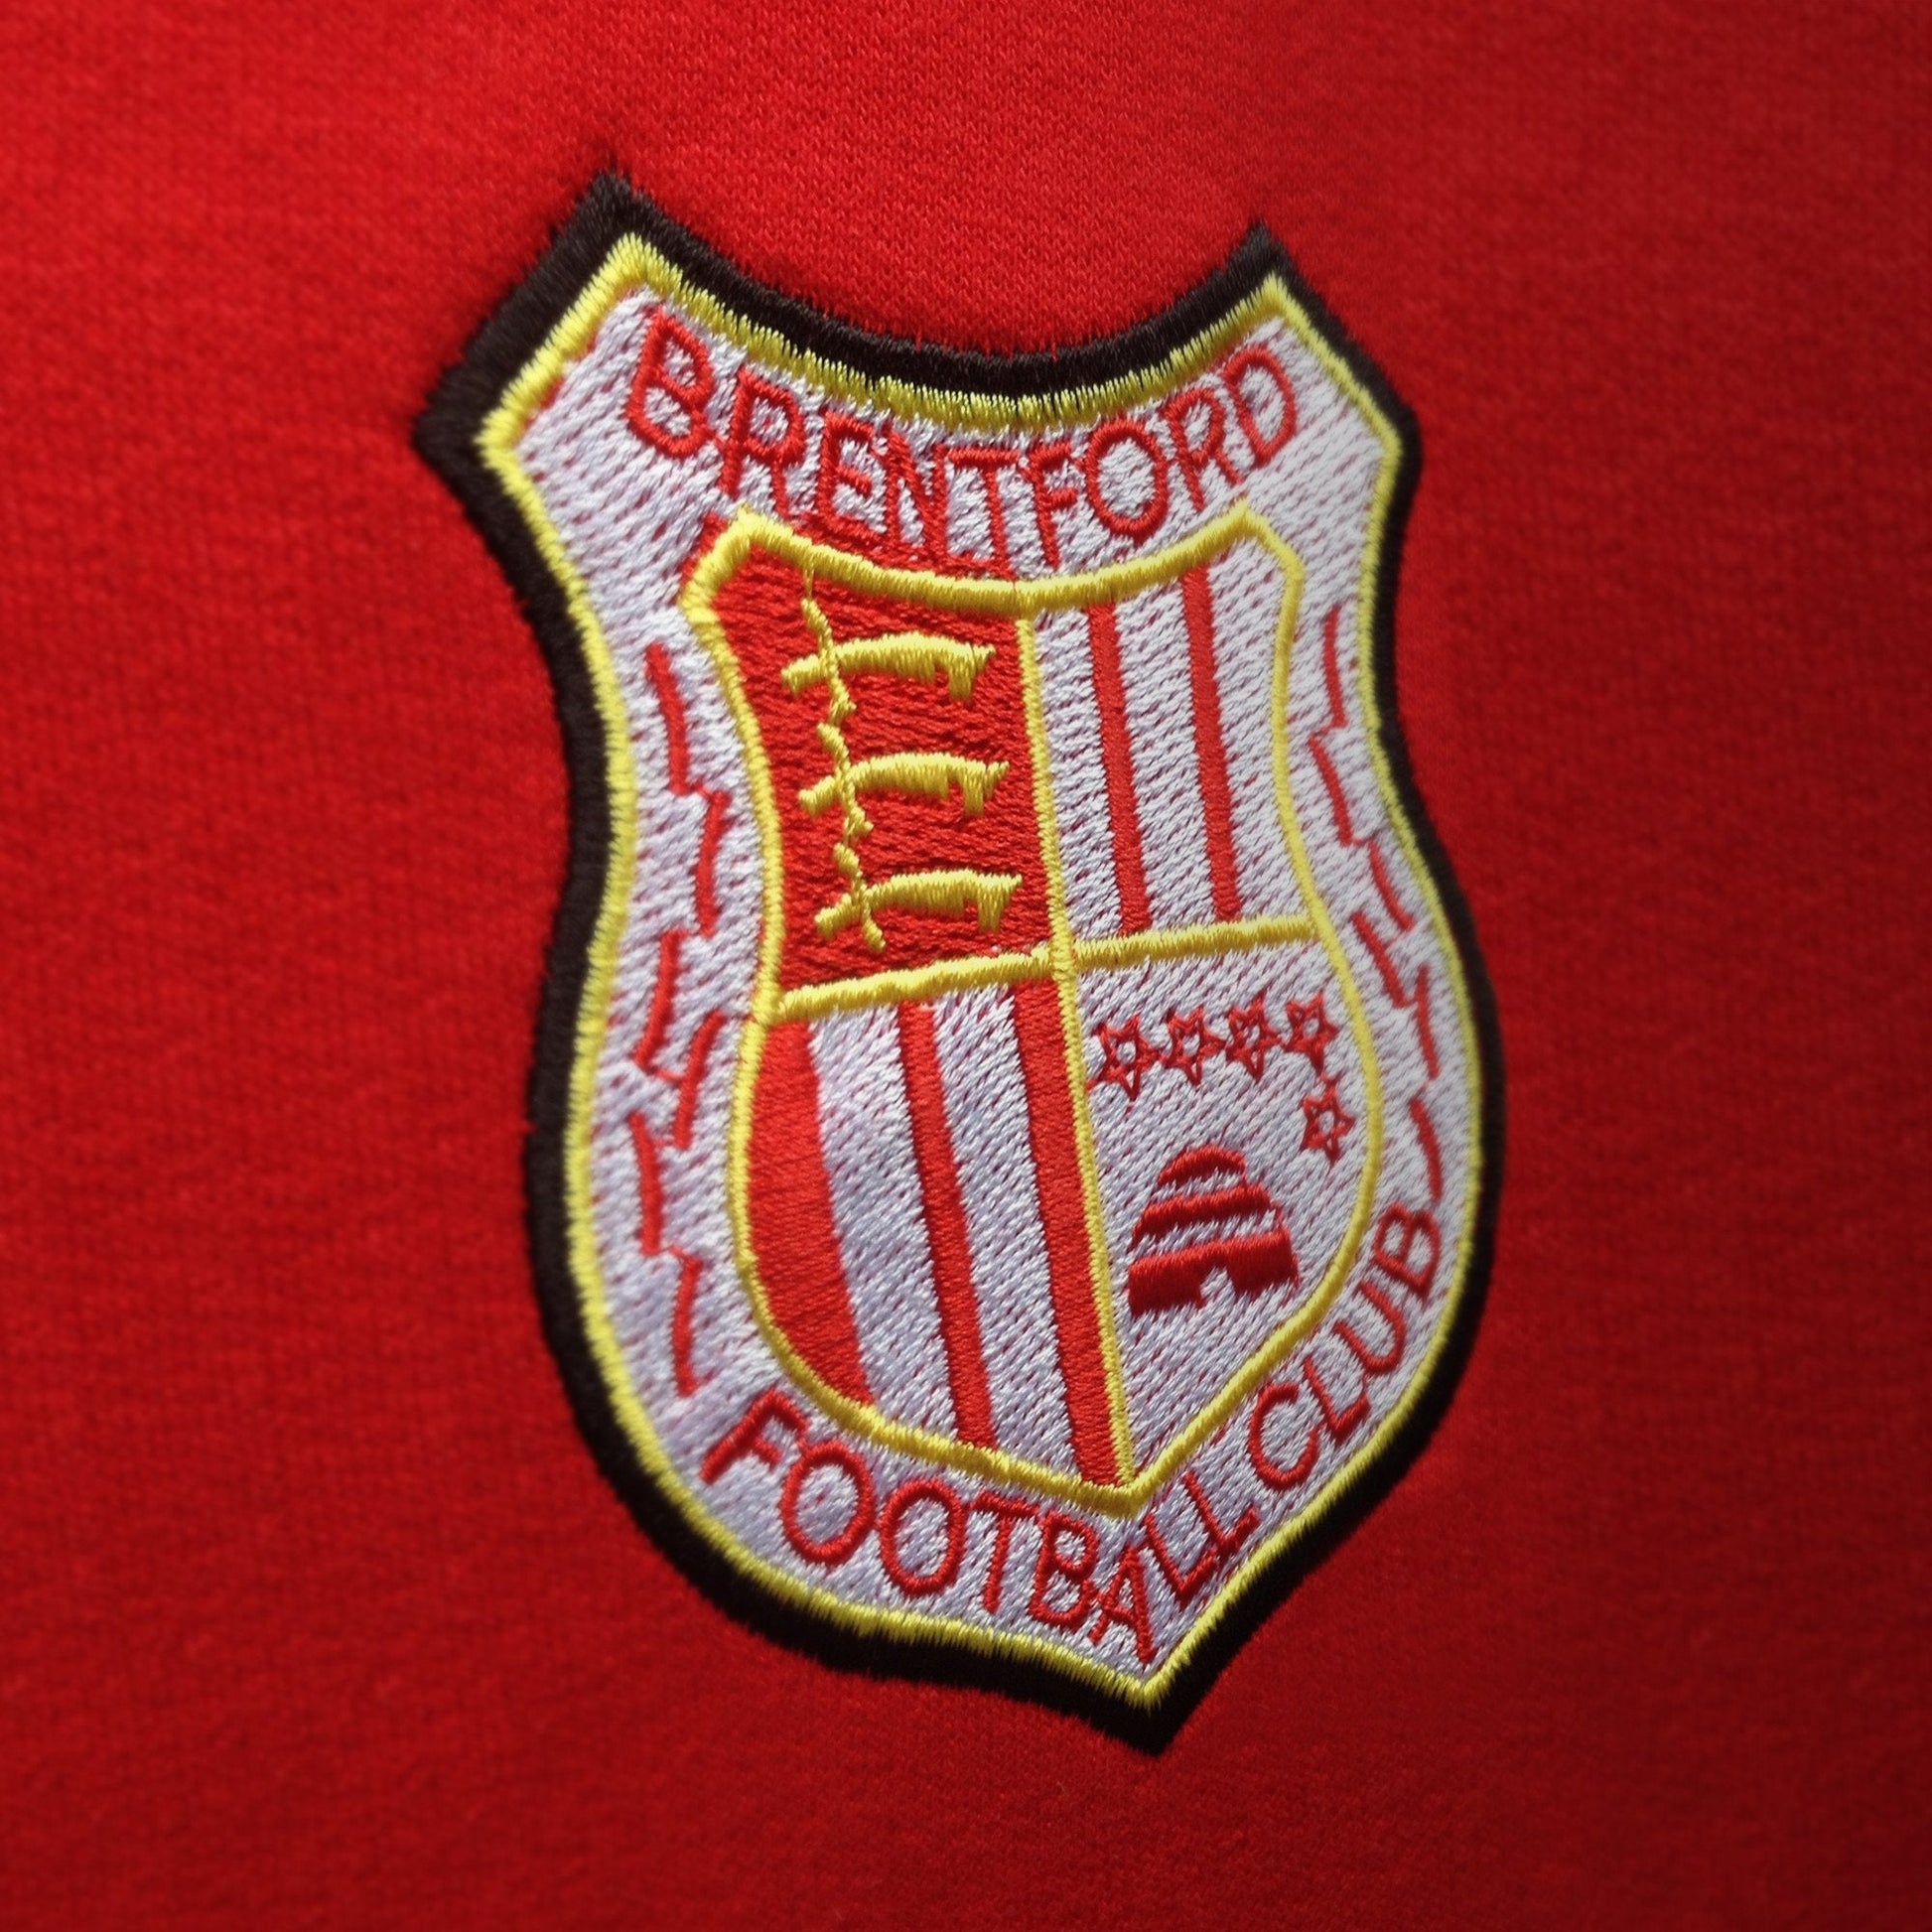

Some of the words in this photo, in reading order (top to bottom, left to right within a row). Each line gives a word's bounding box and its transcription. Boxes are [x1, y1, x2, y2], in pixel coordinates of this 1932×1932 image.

[624, 305, 1298, 573] BRENTFORD
[700, 1391, 1261, 1664] FOOTBALL
[1248, 1205, 1444, 1491] CLUB
